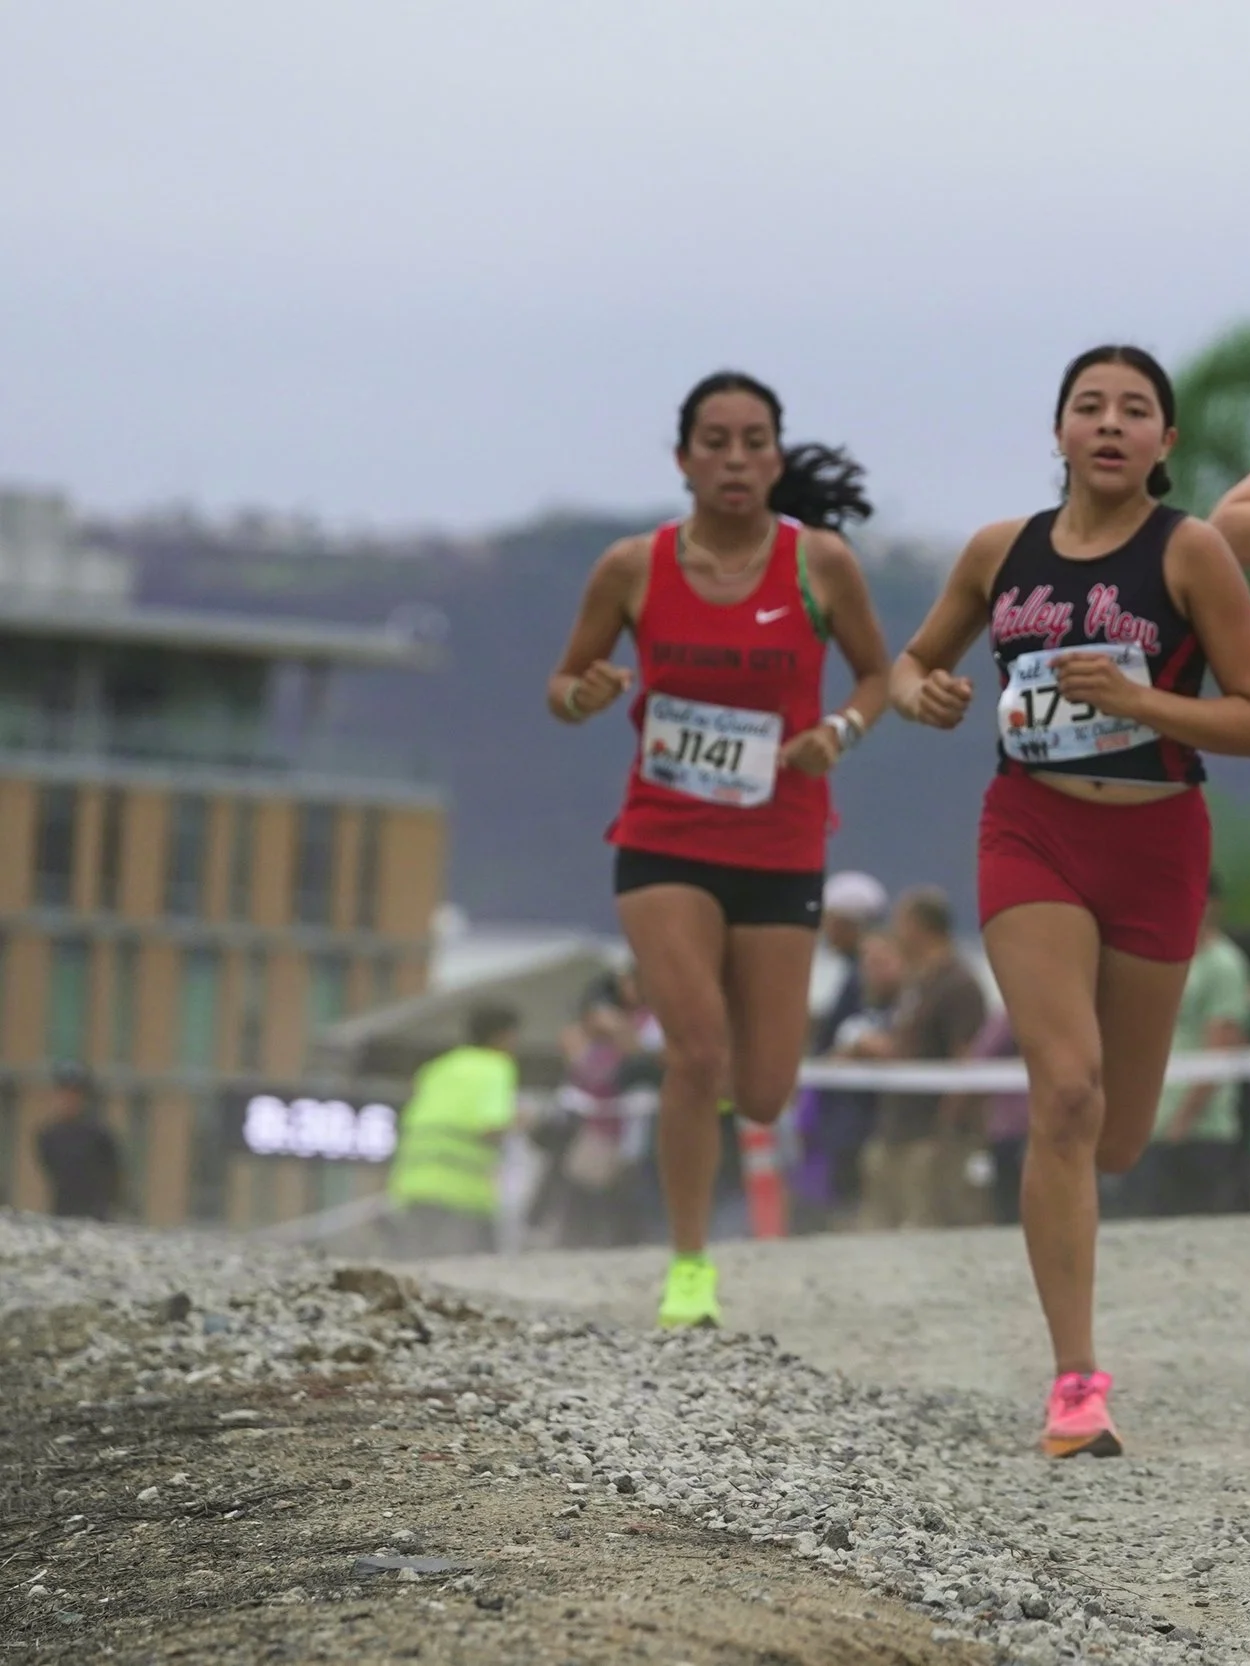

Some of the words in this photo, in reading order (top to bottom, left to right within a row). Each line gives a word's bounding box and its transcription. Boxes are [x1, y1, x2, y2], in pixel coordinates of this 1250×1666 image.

[989, 583, 1075, 650] Valley
[1083, 582, 1162, 656] View
[676, 728, 746, 775] 1141
